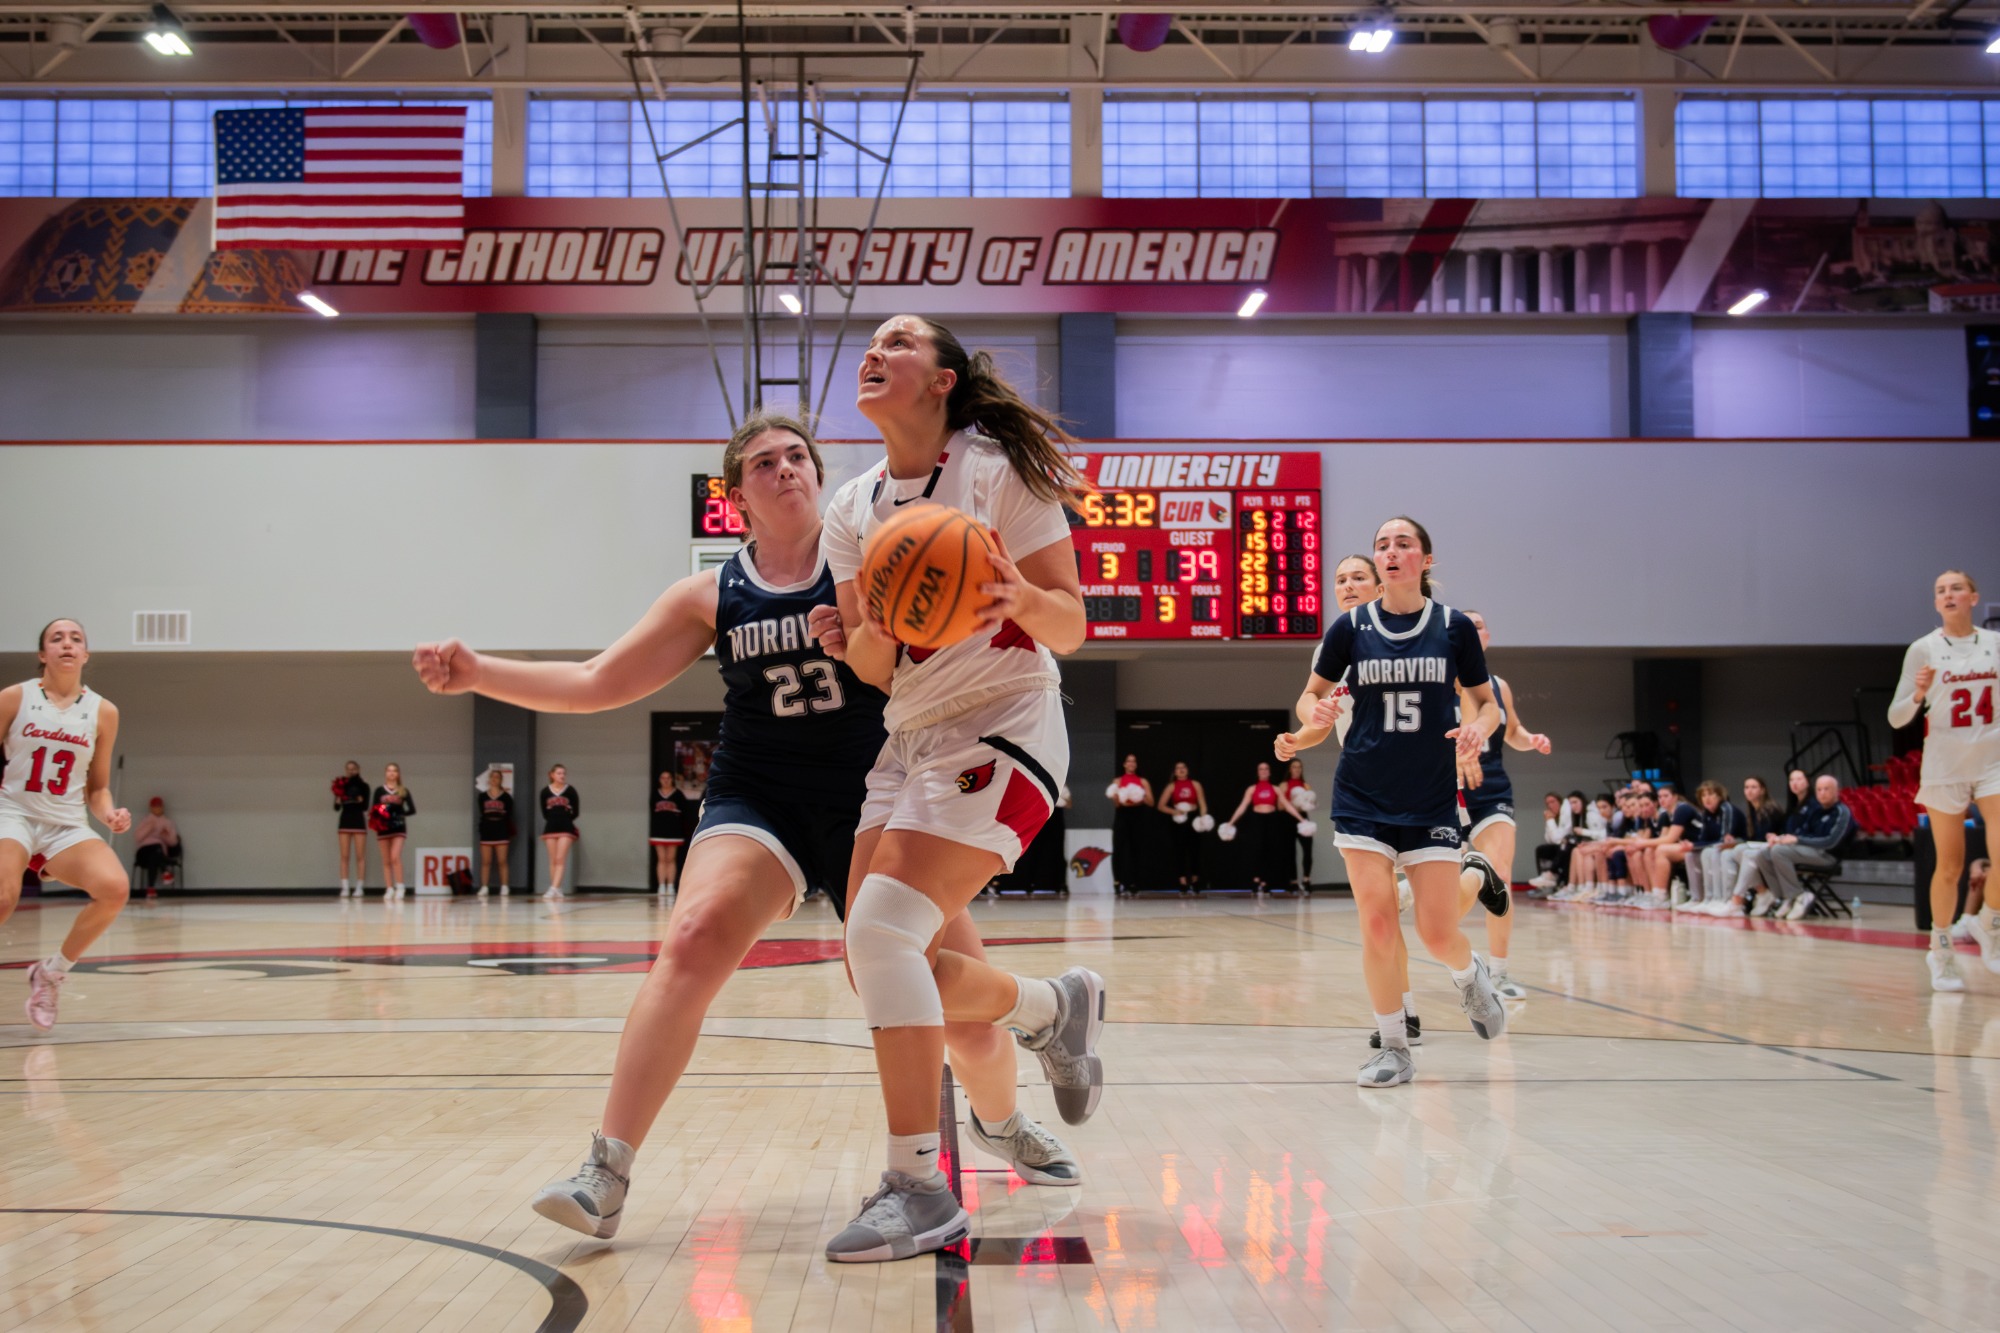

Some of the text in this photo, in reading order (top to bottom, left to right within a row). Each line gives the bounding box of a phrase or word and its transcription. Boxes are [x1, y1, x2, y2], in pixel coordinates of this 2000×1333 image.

[423, 229, 662, 283] CATHOLIC
[678, 229, 970, 283] UNIVERSITY
[980, 239, 1040, 283] OF
[1046, 229, 1278, 283] AMERICA
[1098, 455, 1280, 487] UNIVERSITY
[1084, 494, 1156, 526] 5:32
[1163, 501, 1204, 523] CUA
[1243, 496, 1311, 507] PLYR FLS PTS
[1252, 510, 1317, 531] 5 2 12
[1092, 543, 1125, 552] PERIOD
[1170, 532, 1214, 545] GUEST
[1246, 532, 1318, 552] 15 0 0
[1101, 553, 1119, 580] 3
[1178, 550, 1218, 582] 39
[1241, 552, 1318, 573] 22 1 8
[1081, 585, 1141, 595] PLAYER FOUL
[1153, 585, 1179, 595] T.O.L.
[1191, 585, 1221, 595] FOULS
[1241, 573, 1318, 593] 23 1 5
[903, 564, 947, 633] NCAA
[1158, 596, 1176, 622] 3
[1210, 598, 1219, 619] 1
[1241, 594, 1318, 615] 24 0 10
[1094, 626, 1126, 636] MATCH
[1191, 626, 1221, 636] SCORE
[1279, 616, 1288, 634] 1
[727, 613, 822, 662] MORAV
[1357, 656, 1447, 686] MORAVIAN
[1942, 668, 1997, 683] Cardinals
[763, 659, 845, 717] 23
[1382, 690, 1422, 733] 15
[1951, 685, 1993, 728] 24
[22, 722, 91, 748] Cardinals
[25, 746, 76, 796] 13
